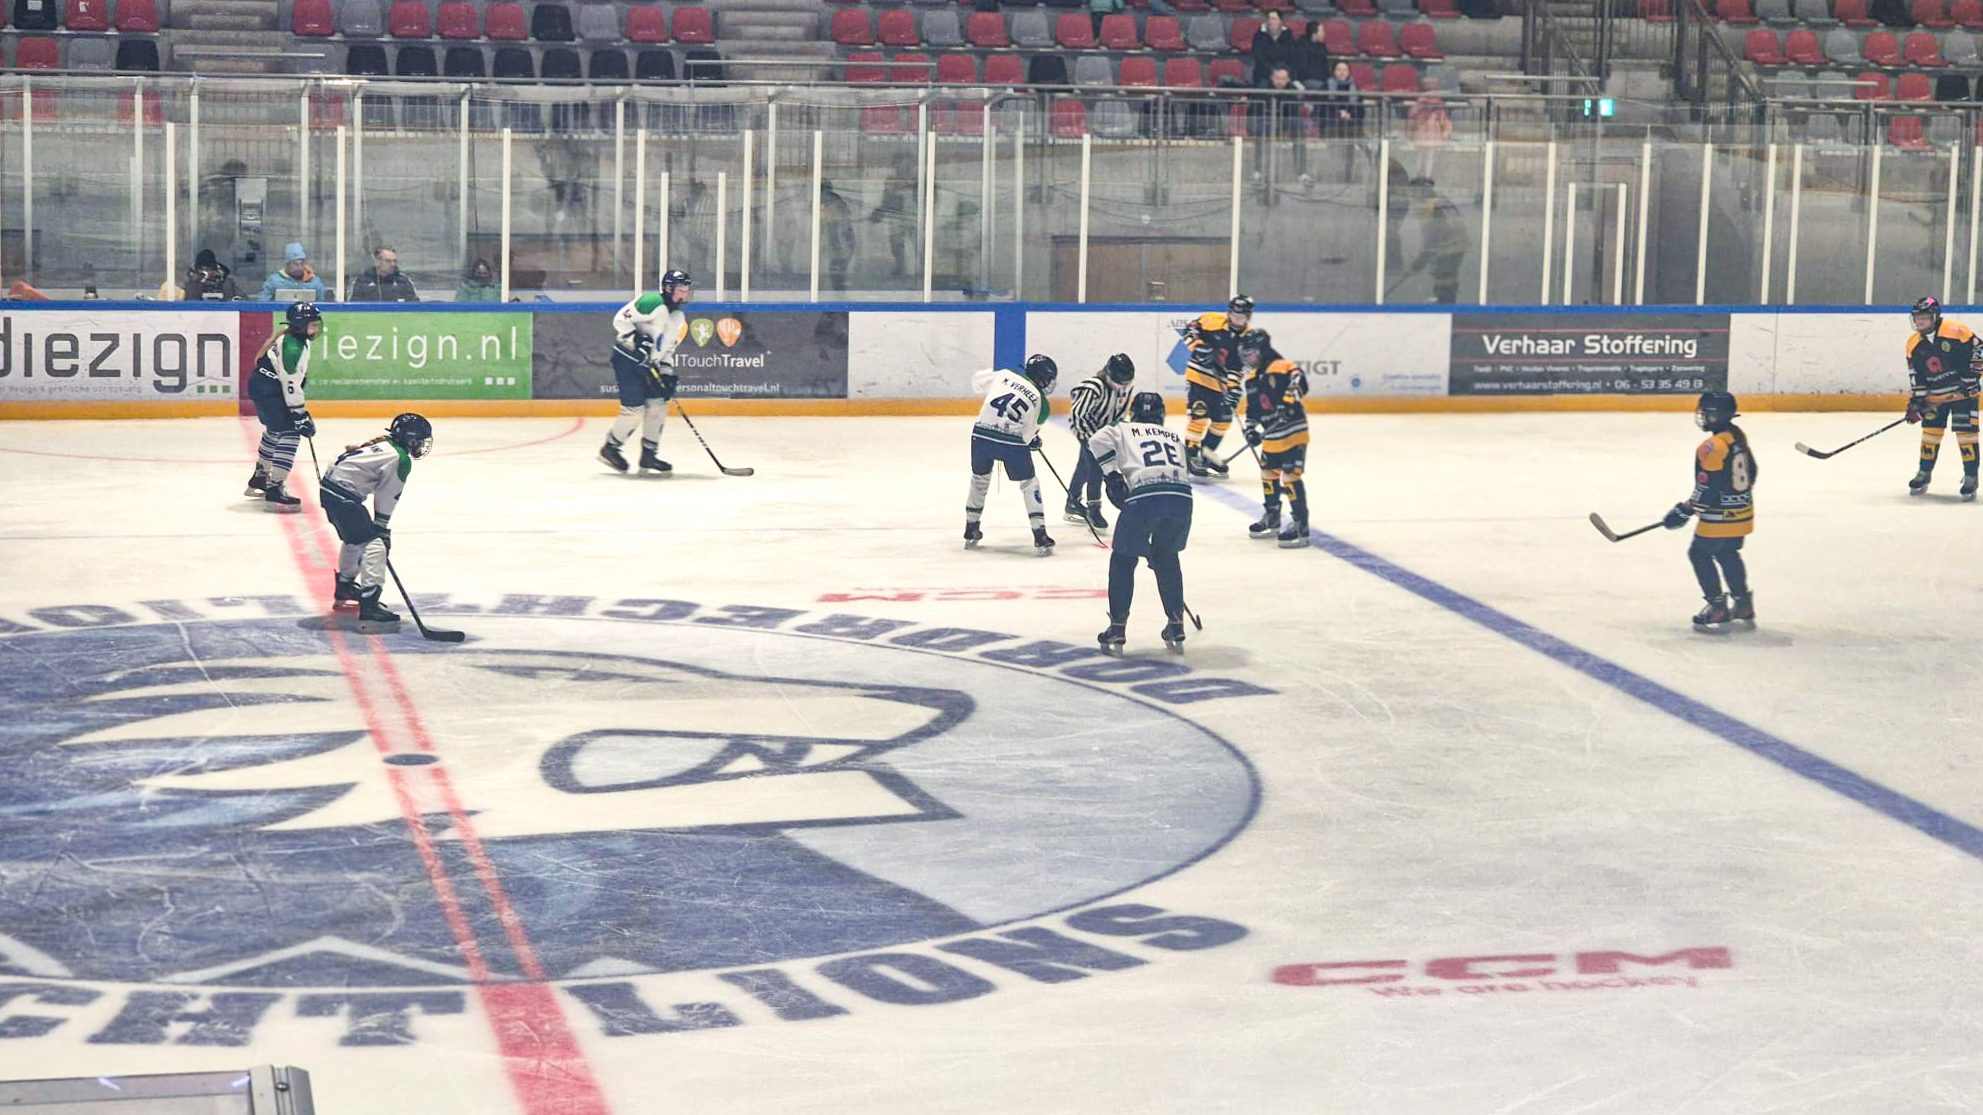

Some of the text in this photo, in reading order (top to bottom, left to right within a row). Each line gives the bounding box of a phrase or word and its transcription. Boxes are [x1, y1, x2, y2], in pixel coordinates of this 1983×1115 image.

[322, 326, 516, 368] iezign.nl
[1482, 335, 1697, 358] Verhaar Stoffering
[600, 382, 780, 393] sus ersonaltouchtravel.nl
[1614, 380, 1630, 389] 06
[989, 392, 1029, 423] 45
[562, 903, 1250, 1038] LIONS
[1271, 946, 1733, 987] CCM
